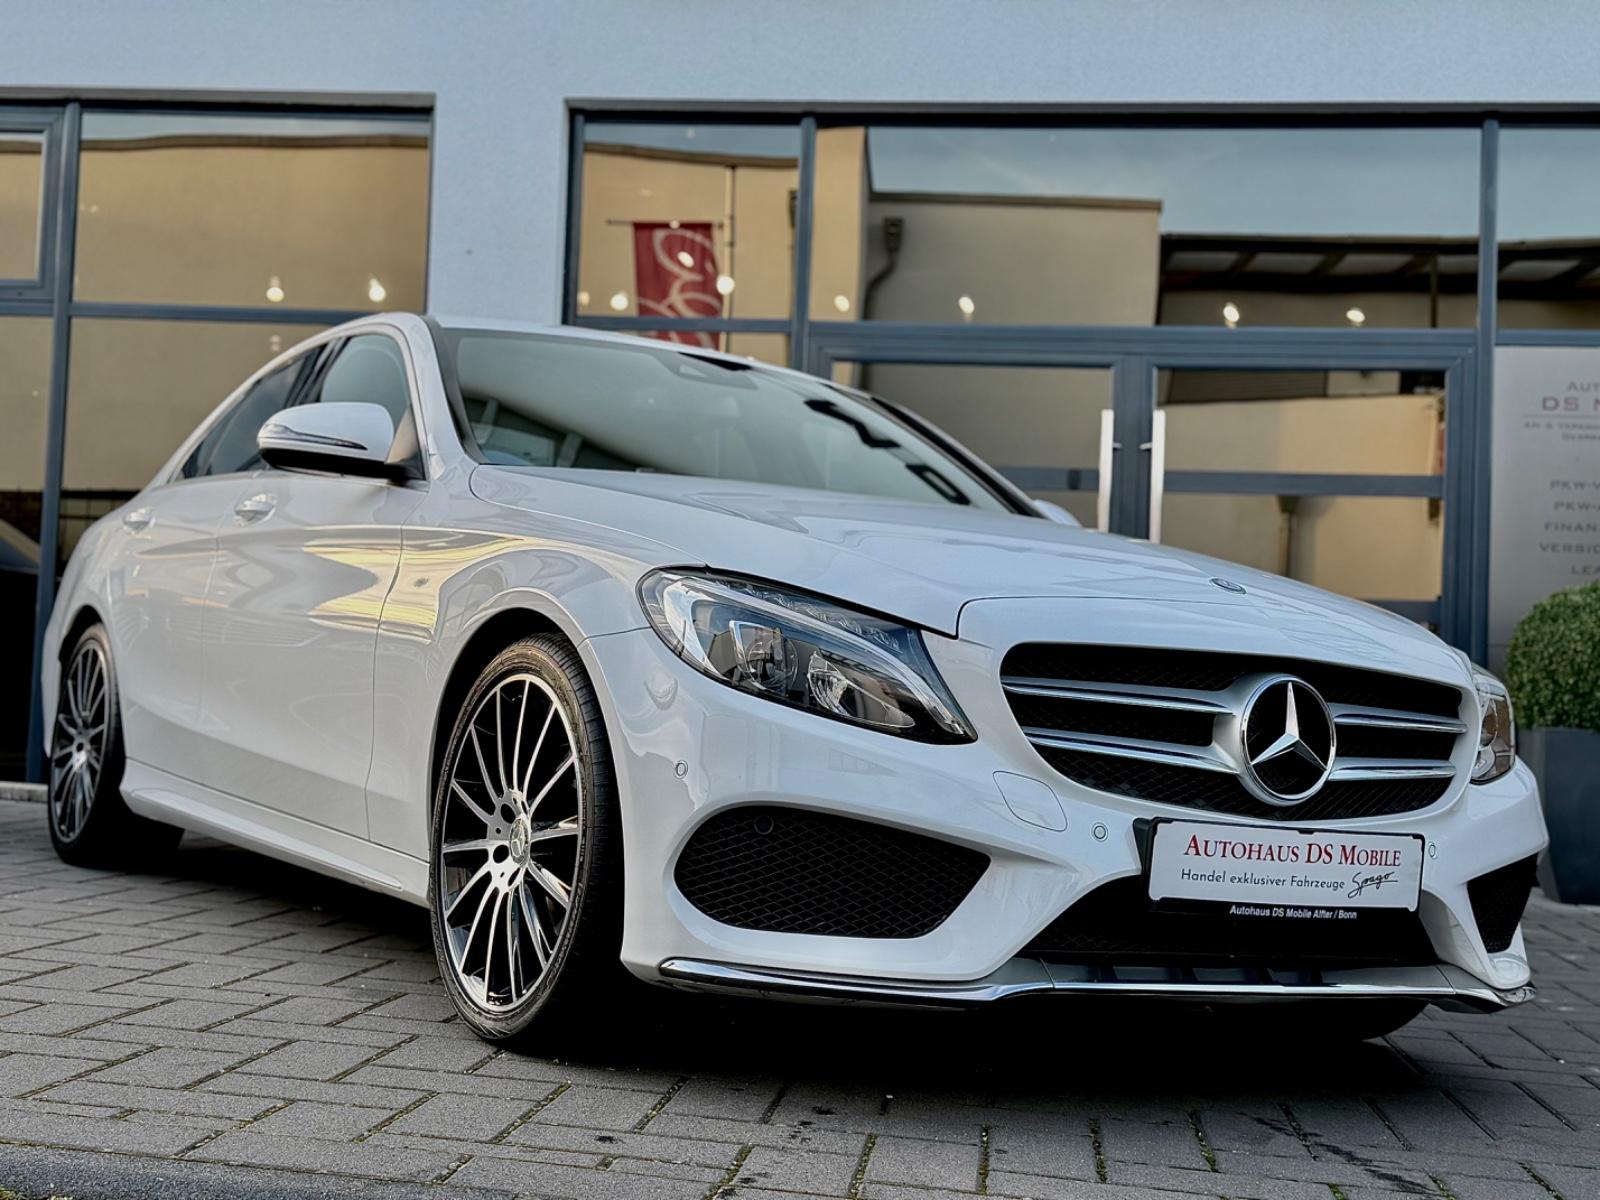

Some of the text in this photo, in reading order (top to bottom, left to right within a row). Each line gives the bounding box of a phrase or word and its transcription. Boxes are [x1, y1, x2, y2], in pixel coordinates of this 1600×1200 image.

[1542, 396, 1580, 412] DS
[1544, 522, 1600, 533] FINAN
[1183, 834, 1402, 867] AUTOHAUS DS MOBILE
[1181, 868, 1345, 891] Handel exklusiver Fahrzeuge
[1229, 905, 1270, 917] Autohaus
[1272, 907, 1285, 917] DS
[1286, 908, 1312, 918] Mobile
[1338, 910, 1358, 920] Bonn
